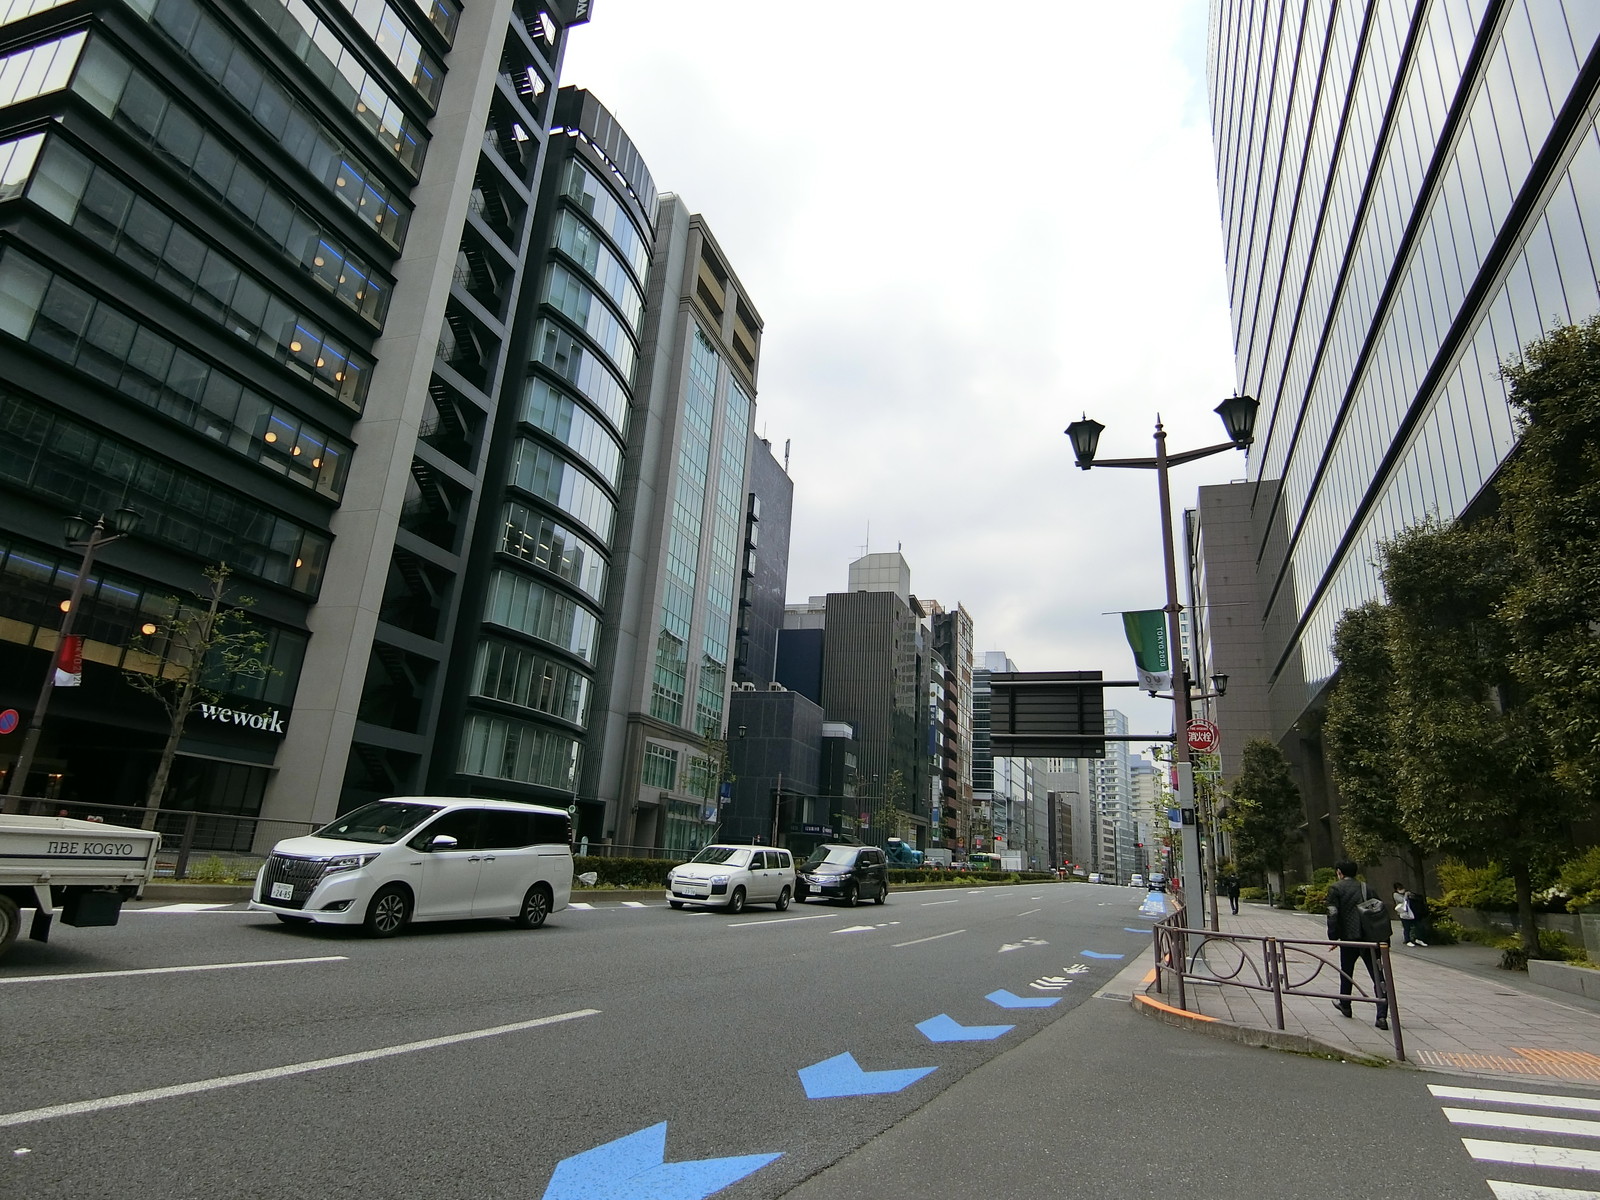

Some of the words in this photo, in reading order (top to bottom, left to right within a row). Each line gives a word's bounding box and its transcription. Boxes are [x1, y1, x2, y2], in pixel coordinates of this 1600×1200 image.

[1156, 626, 1165, 650] TOKYO
[1158, 650, 1167, 667] 2020
[200, 703, 285, 734] wework
[1188, 731, 1212, 742] 消火栓
[82, 842, 133, 855] KOGYO
